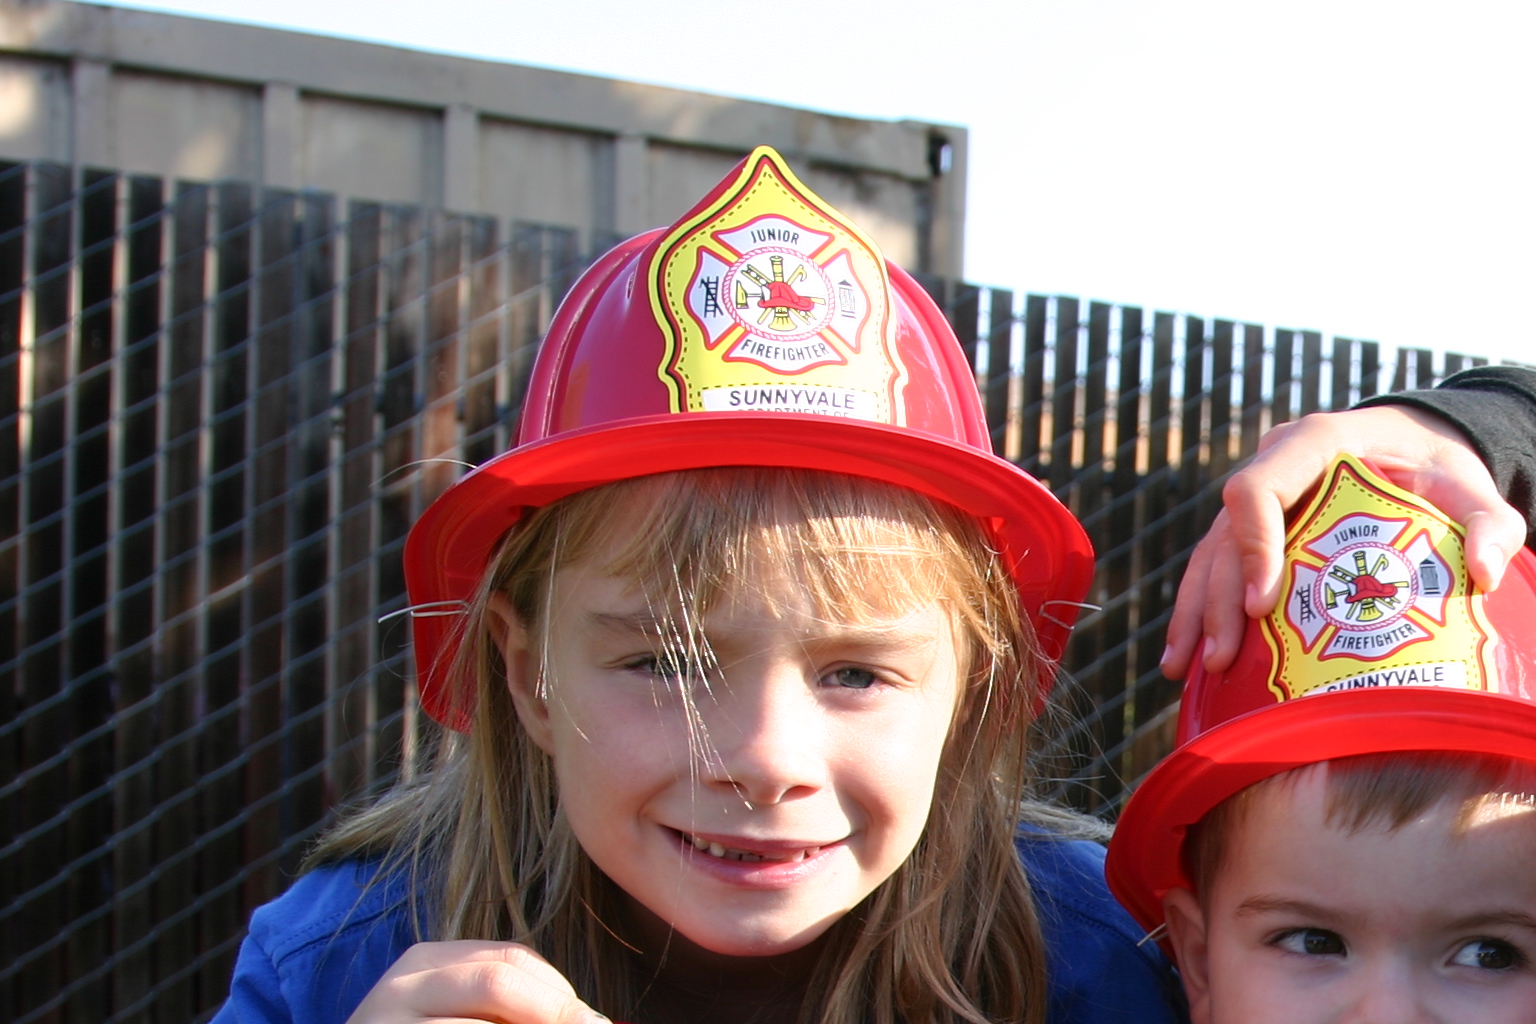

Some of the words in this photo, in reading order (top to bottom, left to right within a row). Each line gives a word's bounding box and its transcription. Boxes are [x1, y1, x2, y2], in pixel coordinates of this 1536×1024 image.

[750, 228, 800, 245] JUNIOR
[740, 339, 830, 361] FIREFIGHTER
[729, 389, 855, 410] SUNNYVALE
[1334, 525, 1379, 545] JUNIOR
[1333, 623, 1417, 650] FIREFIGHTER
